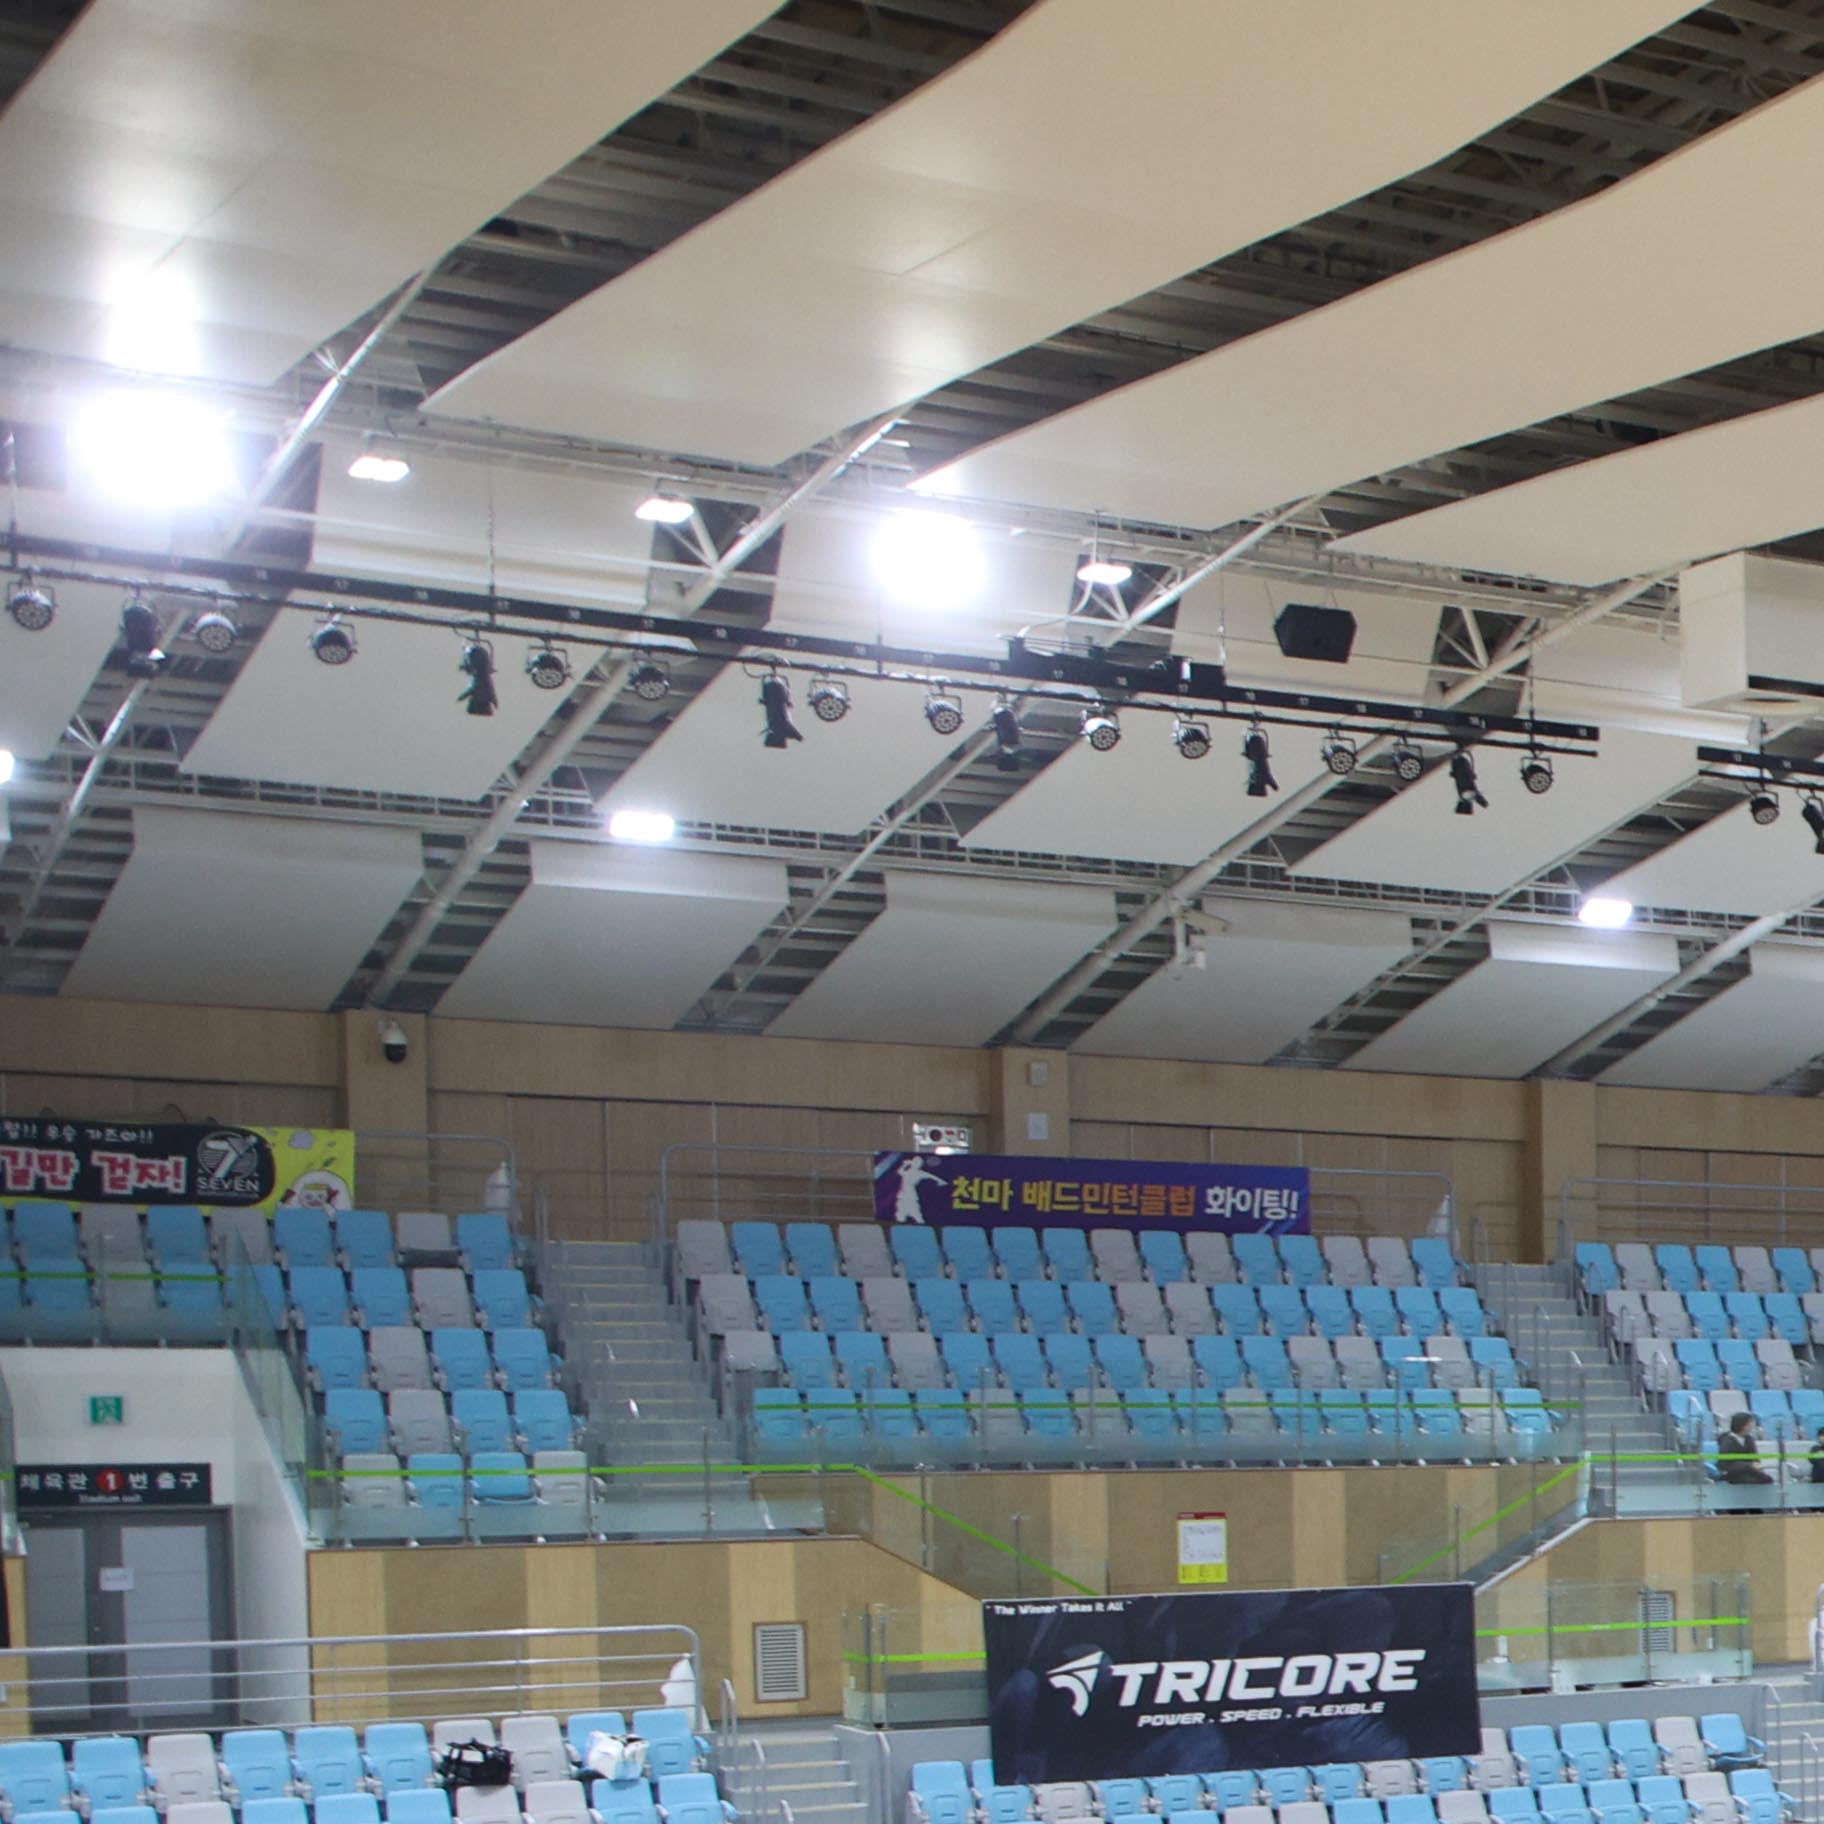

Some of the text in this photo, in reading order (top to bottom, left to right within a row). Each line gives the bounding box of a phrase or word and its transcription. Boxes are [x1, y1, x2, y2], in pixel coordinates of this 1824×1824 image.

[91, 1151, 188, 1194] 걷자!
[198, 1178, 259, 1192] SEVEN
[951, 1174, 1299, 1221] 천마 배드민턴클럽 화이팅!
[19, 1472, 90, 1491] 체육관
[1017, 1604, 1059, 1615] Winner
[1060, 1602, 1093, 1614] Takes
[1109, 1648, 1427, 1708] TRICORE
[1137, 1701, 1386, 1728] POWER SPEED FLEXIBLE
